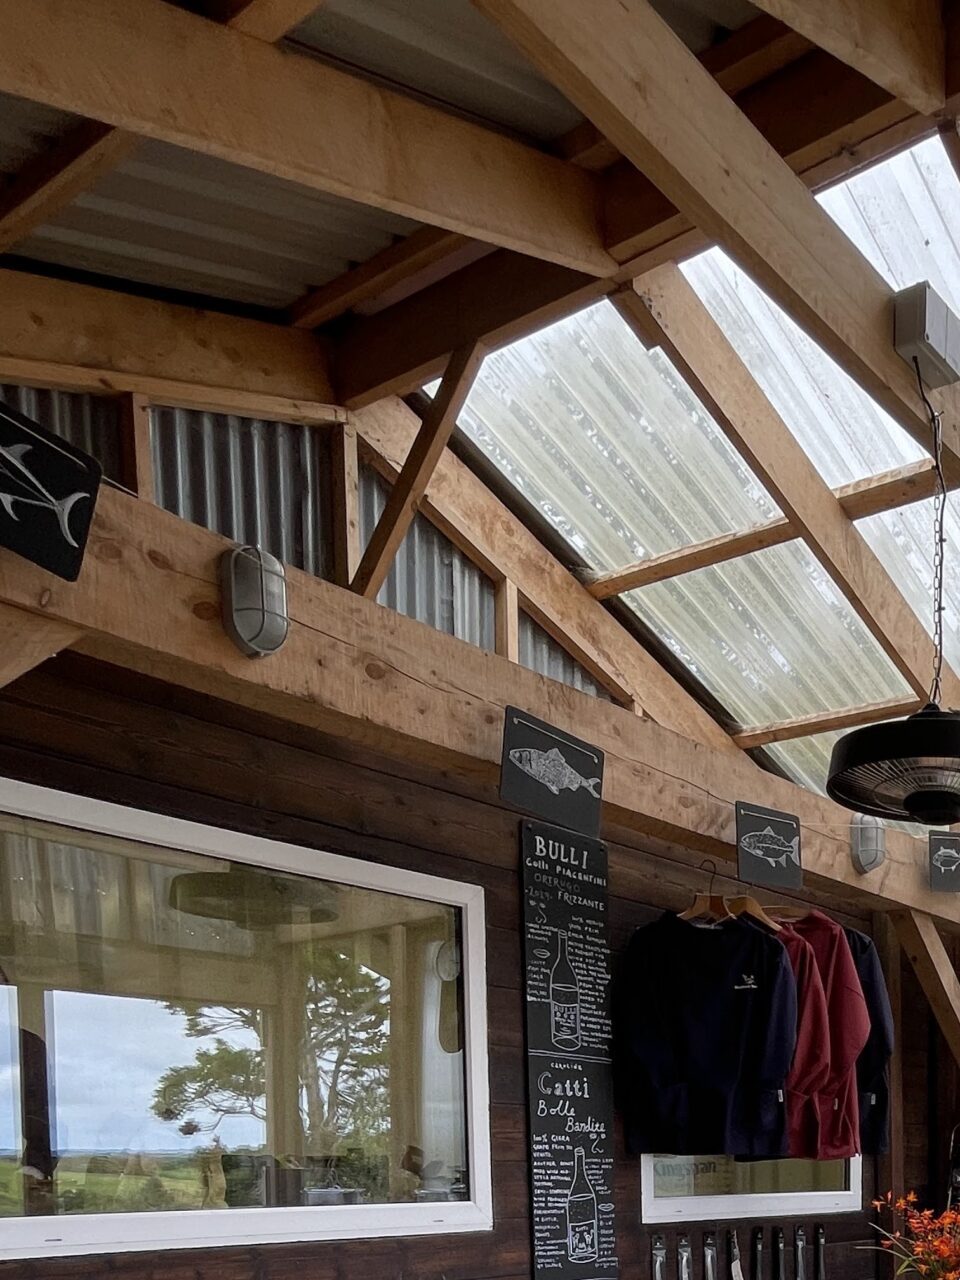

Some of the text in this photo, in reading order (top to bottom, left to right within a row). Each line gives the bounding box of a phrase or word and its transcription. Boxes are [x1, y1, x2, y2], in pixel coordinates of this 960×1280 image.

[535, 836, 588, 869] BULLI
[556, 865, 606, 887] PIACENTINI
[558, 891, 605, 911] FRIZZANTE
[537, 1100, 576, 1116] Bolle
[565, 1116, 606, 1132] Bandite
